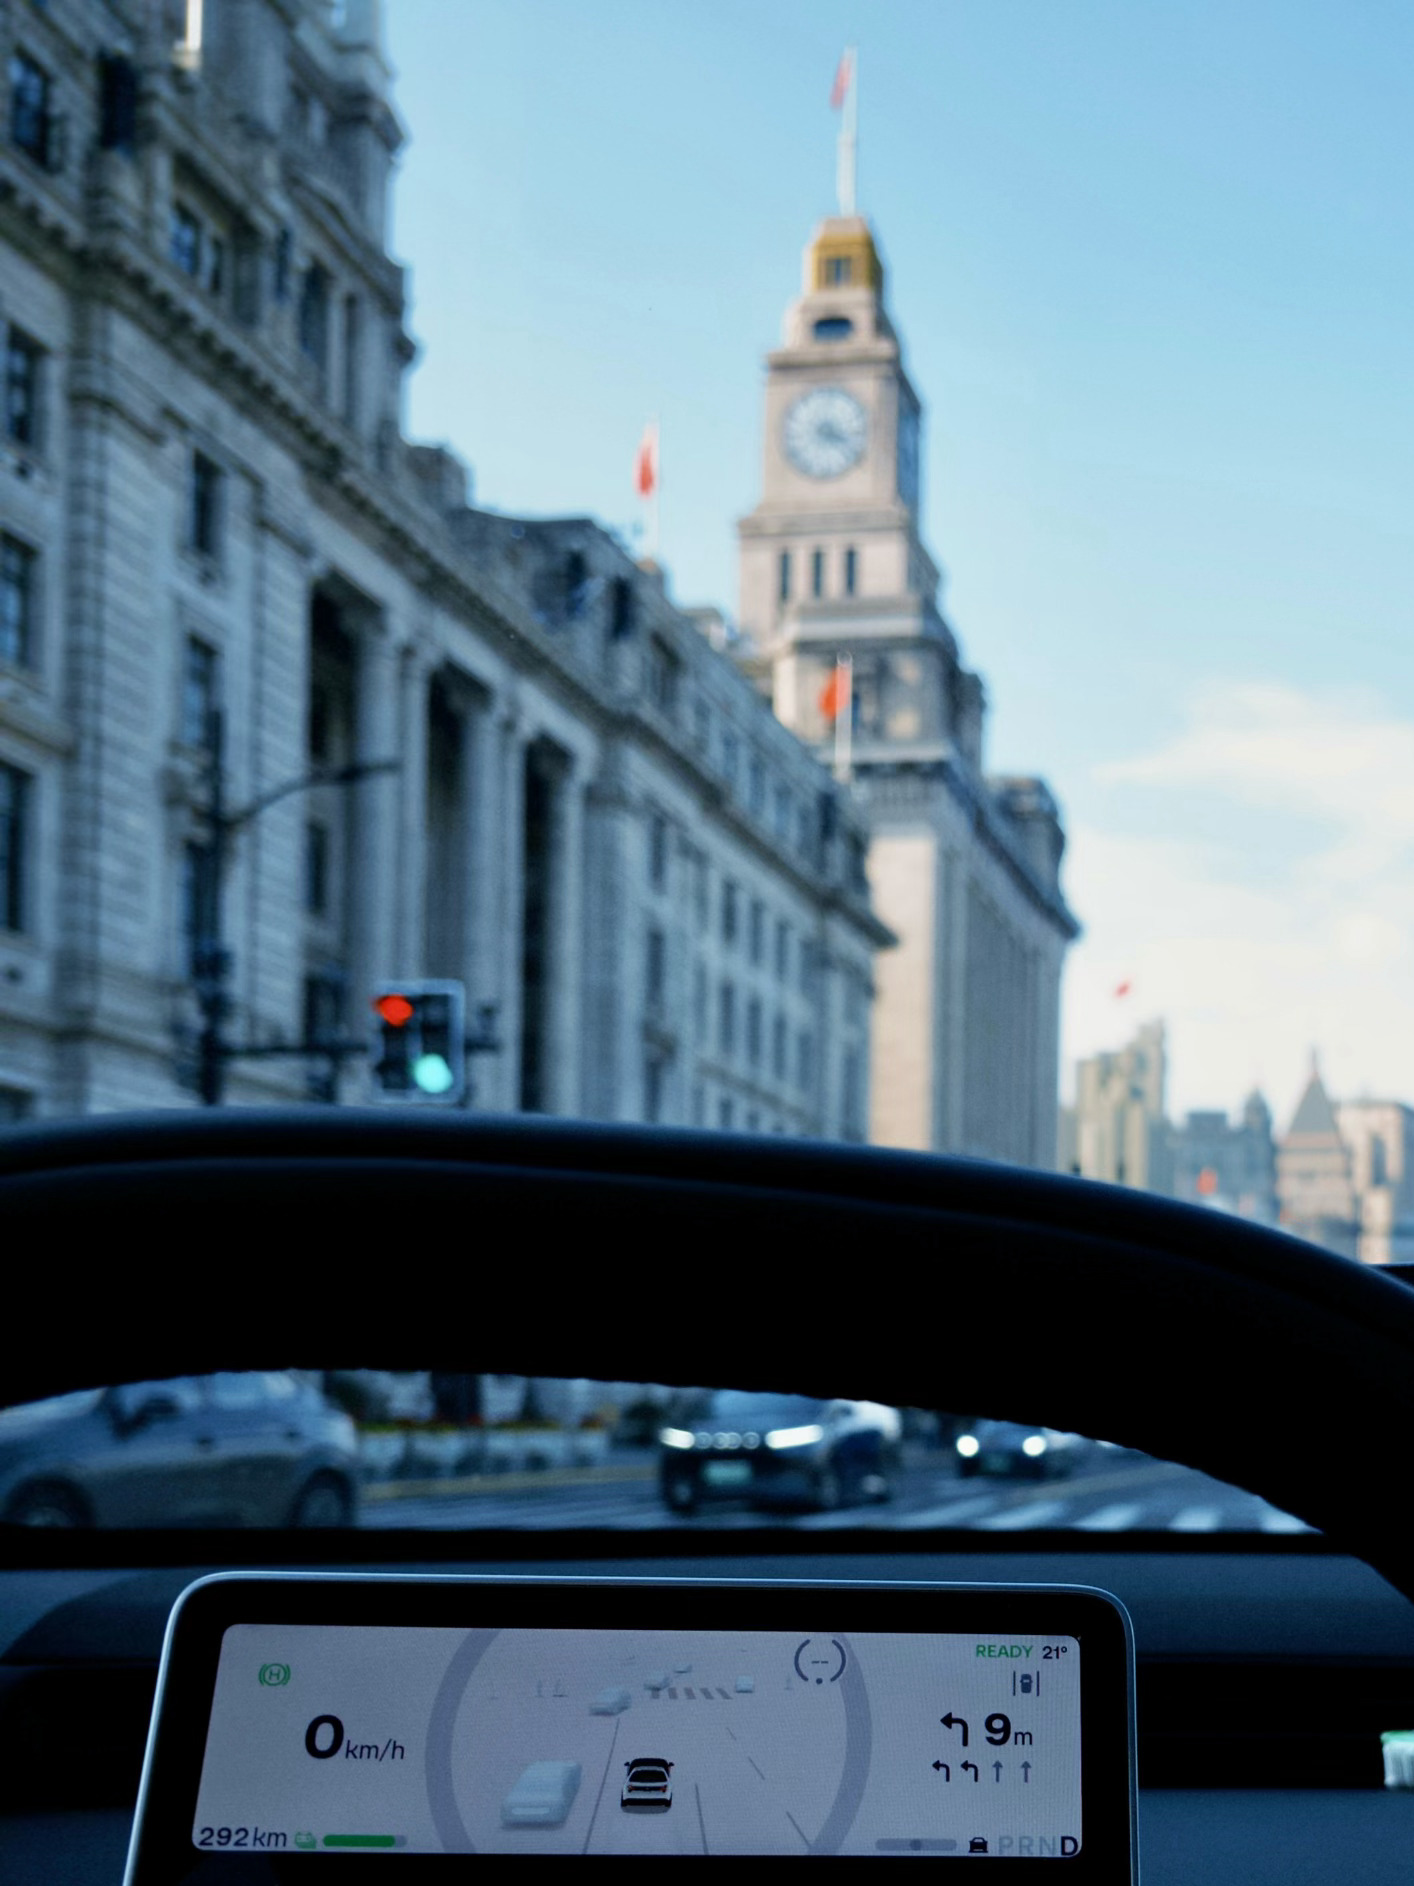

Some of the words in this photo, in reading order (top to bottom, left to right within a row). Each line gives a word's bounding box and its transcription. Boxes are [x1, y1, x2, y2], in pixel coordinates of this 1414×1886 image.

[976, 1644, 1034, 1658] READY
[198, 1827, 249, 1847] 292
[252, 1827, 287, 1847] km
